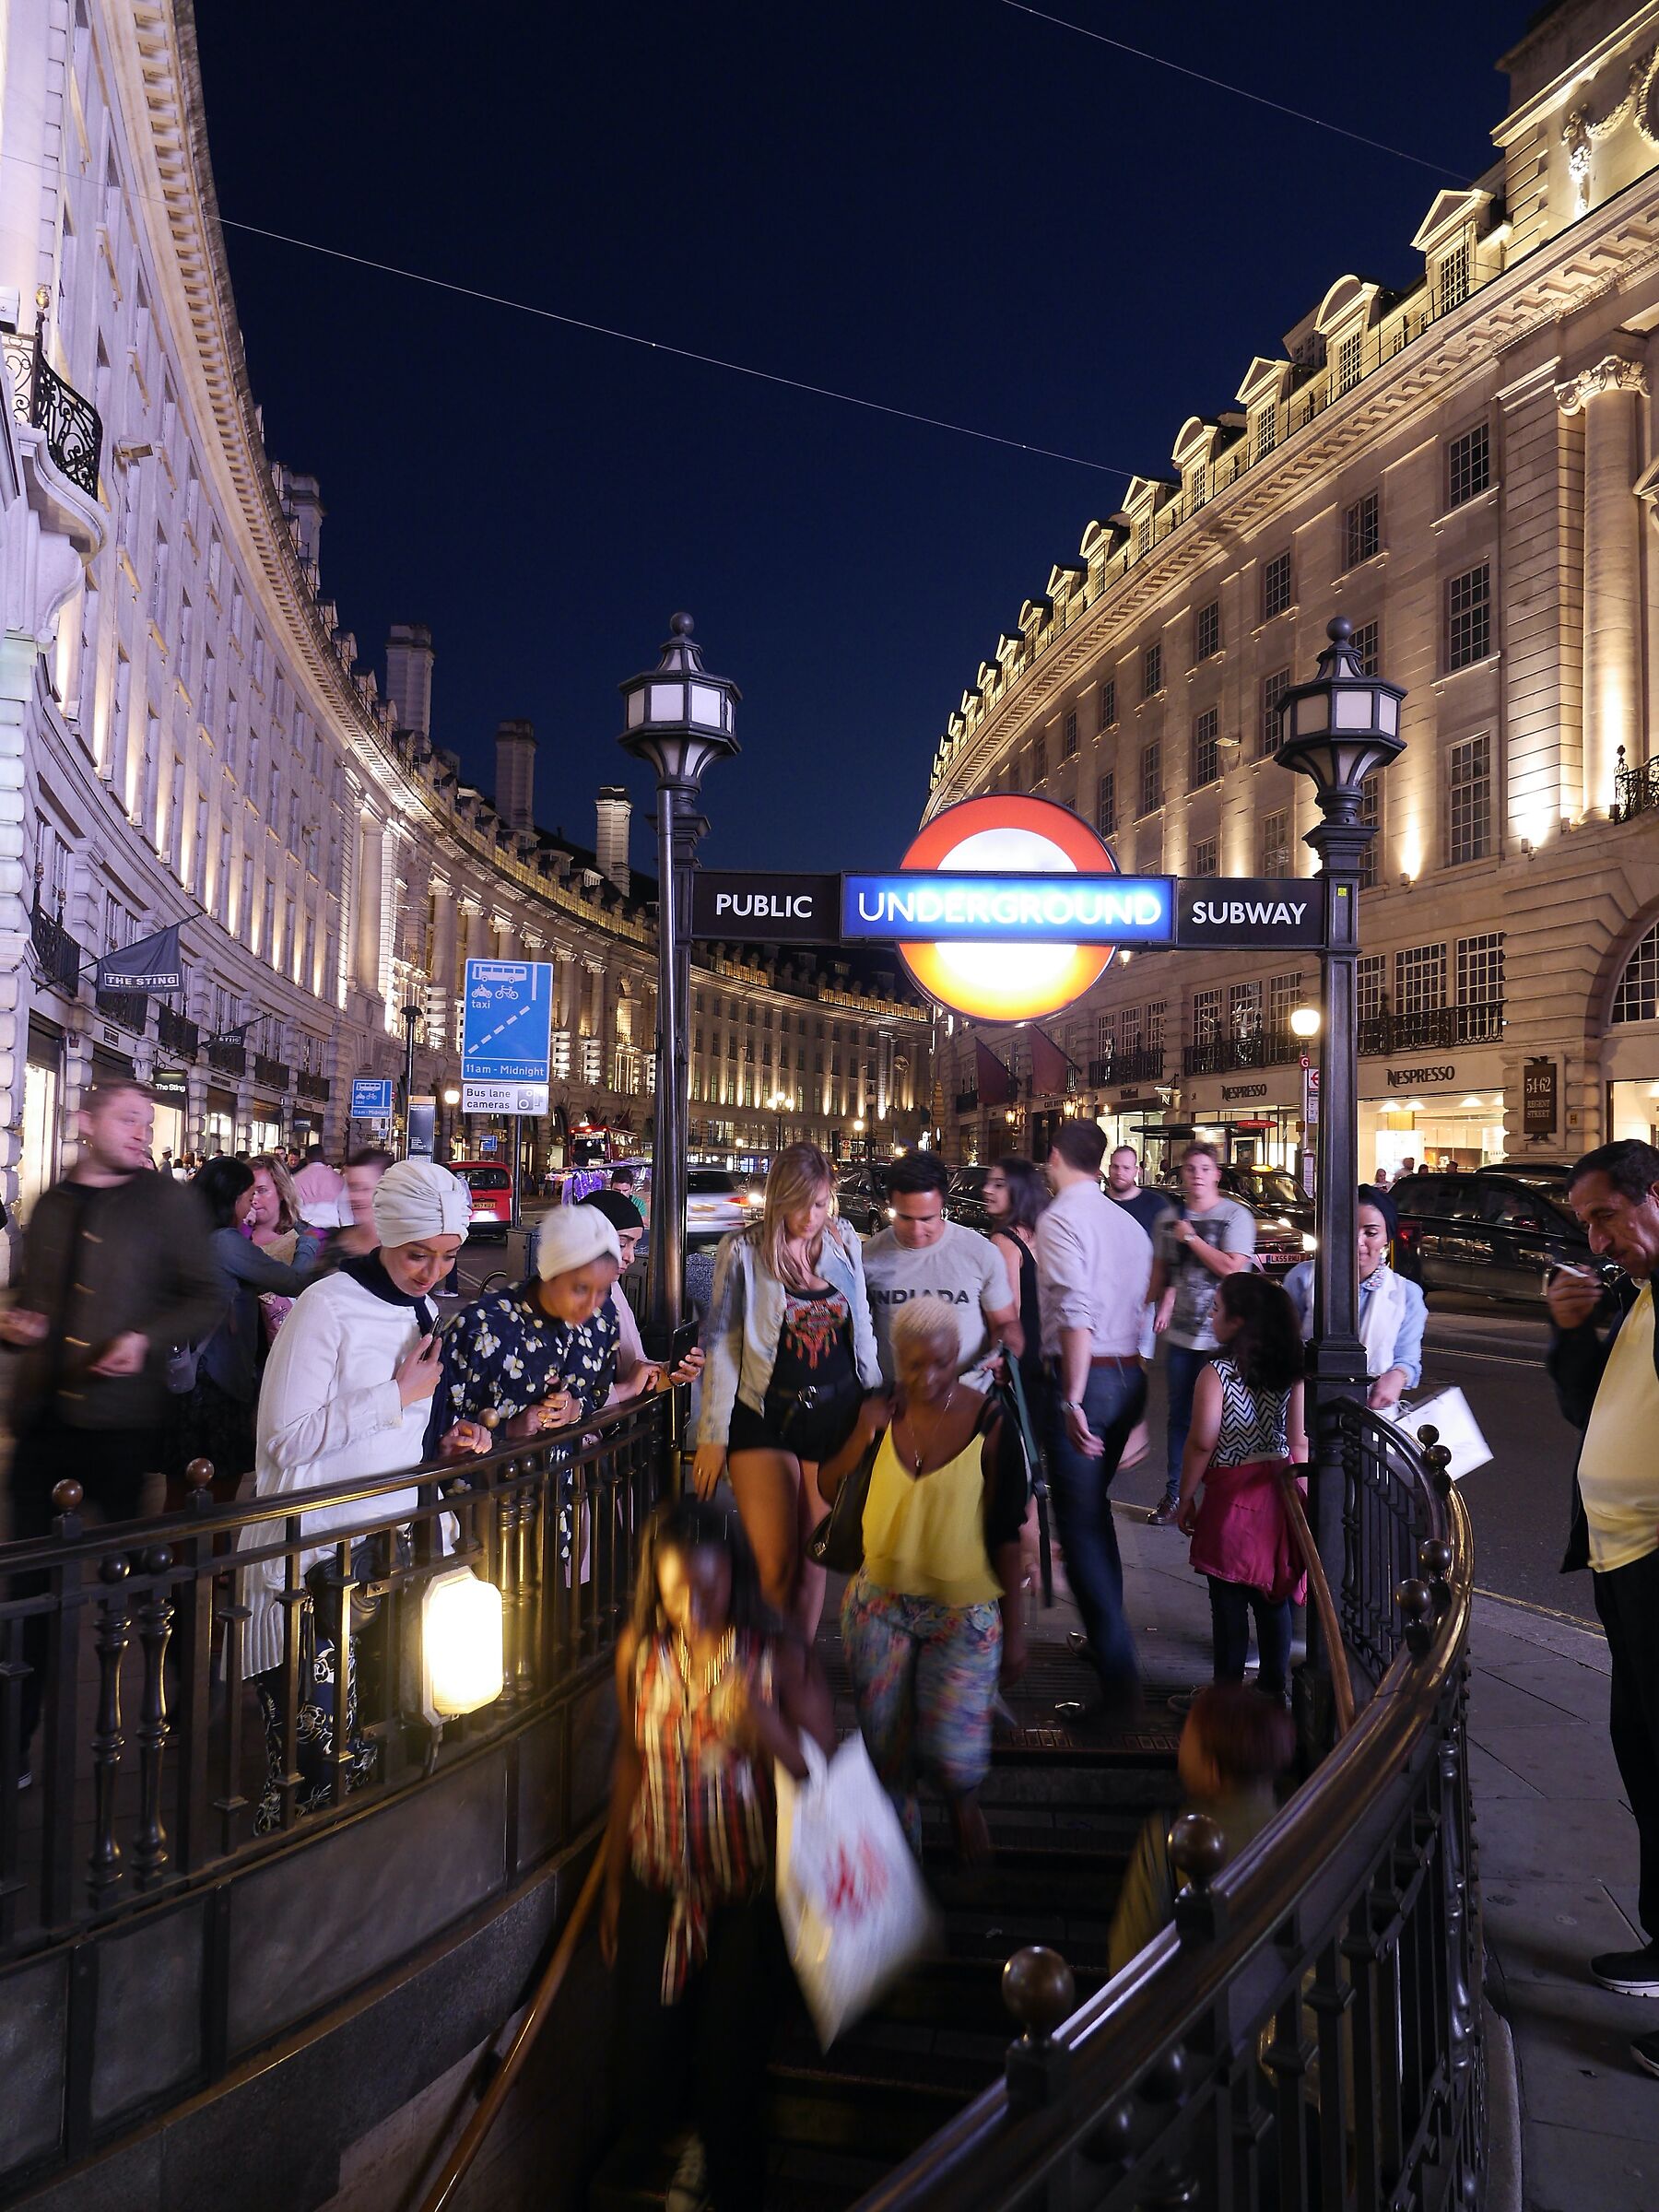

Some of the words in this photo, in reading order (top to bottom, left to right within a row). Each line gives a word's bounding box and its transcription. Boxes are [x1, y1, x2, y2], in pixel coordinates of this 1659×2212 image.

[715, 893, 814, 919] PUBLIC
[858, 892, 1162, 926] UNDERGROUND
[1191, 901, 1308, 925] SUBWAY
[107, 976, 133, 985] THE
[136, 976, 176, 986] STING
[471, 999, 490, 1009] taxi
[1300, 1058, 1309, 1066] G
[465, 1064, 491, 1074] 11am
[500, 1065, 545, 1077] Midnight
[1385, 1065, 1455, 1088] NESPRESSO
[155, 1083, 169, 1091] The
[169, 1083, 186, 1093] Sting
[466, 1088, 486, 1097] Bus
[489, 1088, 511, 1098] lane
[1220, 1083, 1267, 1101] NESPRESSO
[466, 1100, 511, 1110] cameras
[1271, 1254, 1288, 1263] LX55
